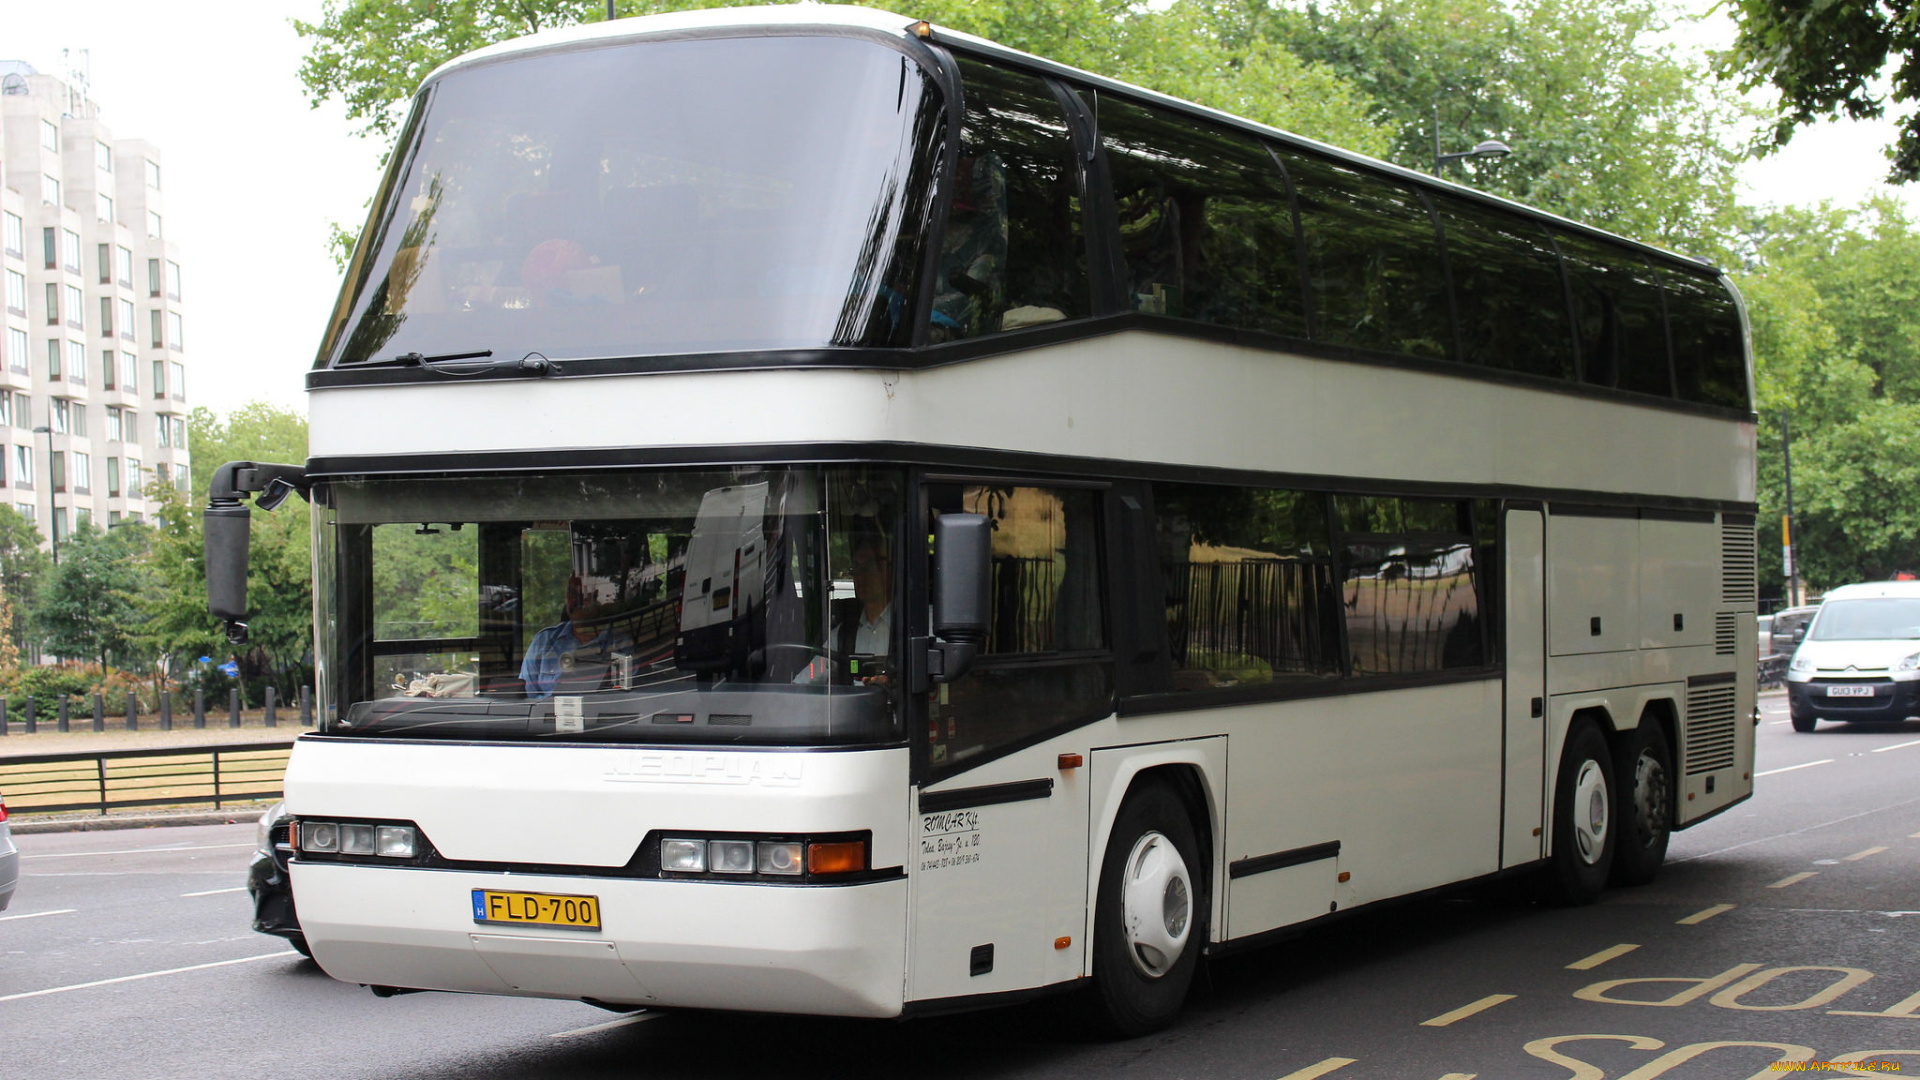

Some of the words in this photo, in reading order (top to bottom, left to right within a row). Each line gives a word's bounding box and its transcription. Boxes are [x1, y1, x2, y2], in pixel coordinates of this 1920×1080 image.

[1832, 687, 1851, 696] GU13
[1852, 687, 1869, 696] VPJ
[603, 754, 804, 780] NEOPLAN
[924, 813, 964, 833] ROMCAR
[476, 907, 485, 916] H
[489, 895, 592, 924] FLD-700
